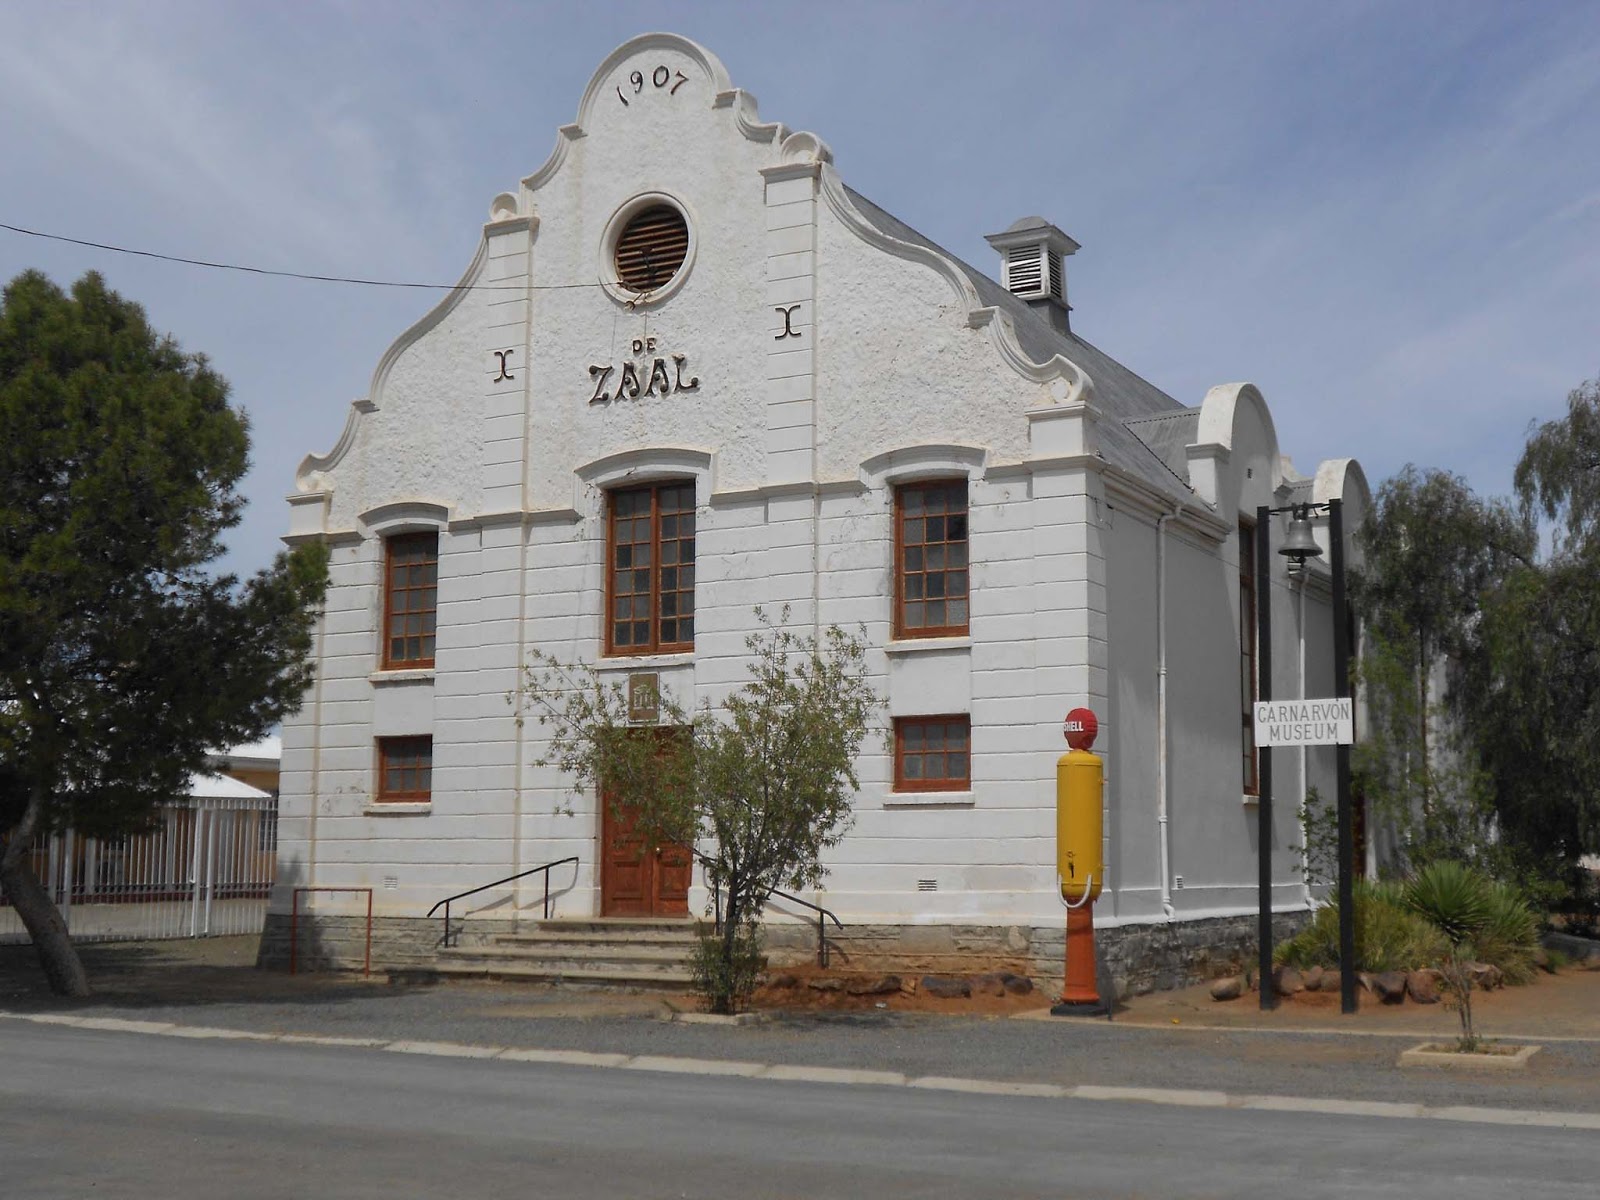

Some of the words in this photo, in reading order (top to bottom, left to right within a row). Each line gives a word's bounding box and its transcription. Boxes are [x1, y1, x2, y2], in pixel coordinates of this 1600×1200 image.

[616, 65, 689, 106] 1907
[632, 338, 657, 352] DE
[588, 353, 699, 404] ZAAL
[1258, 703, 1350, 723] CARNARVON
[1269, 722, 1338, 741] MUSEUM
